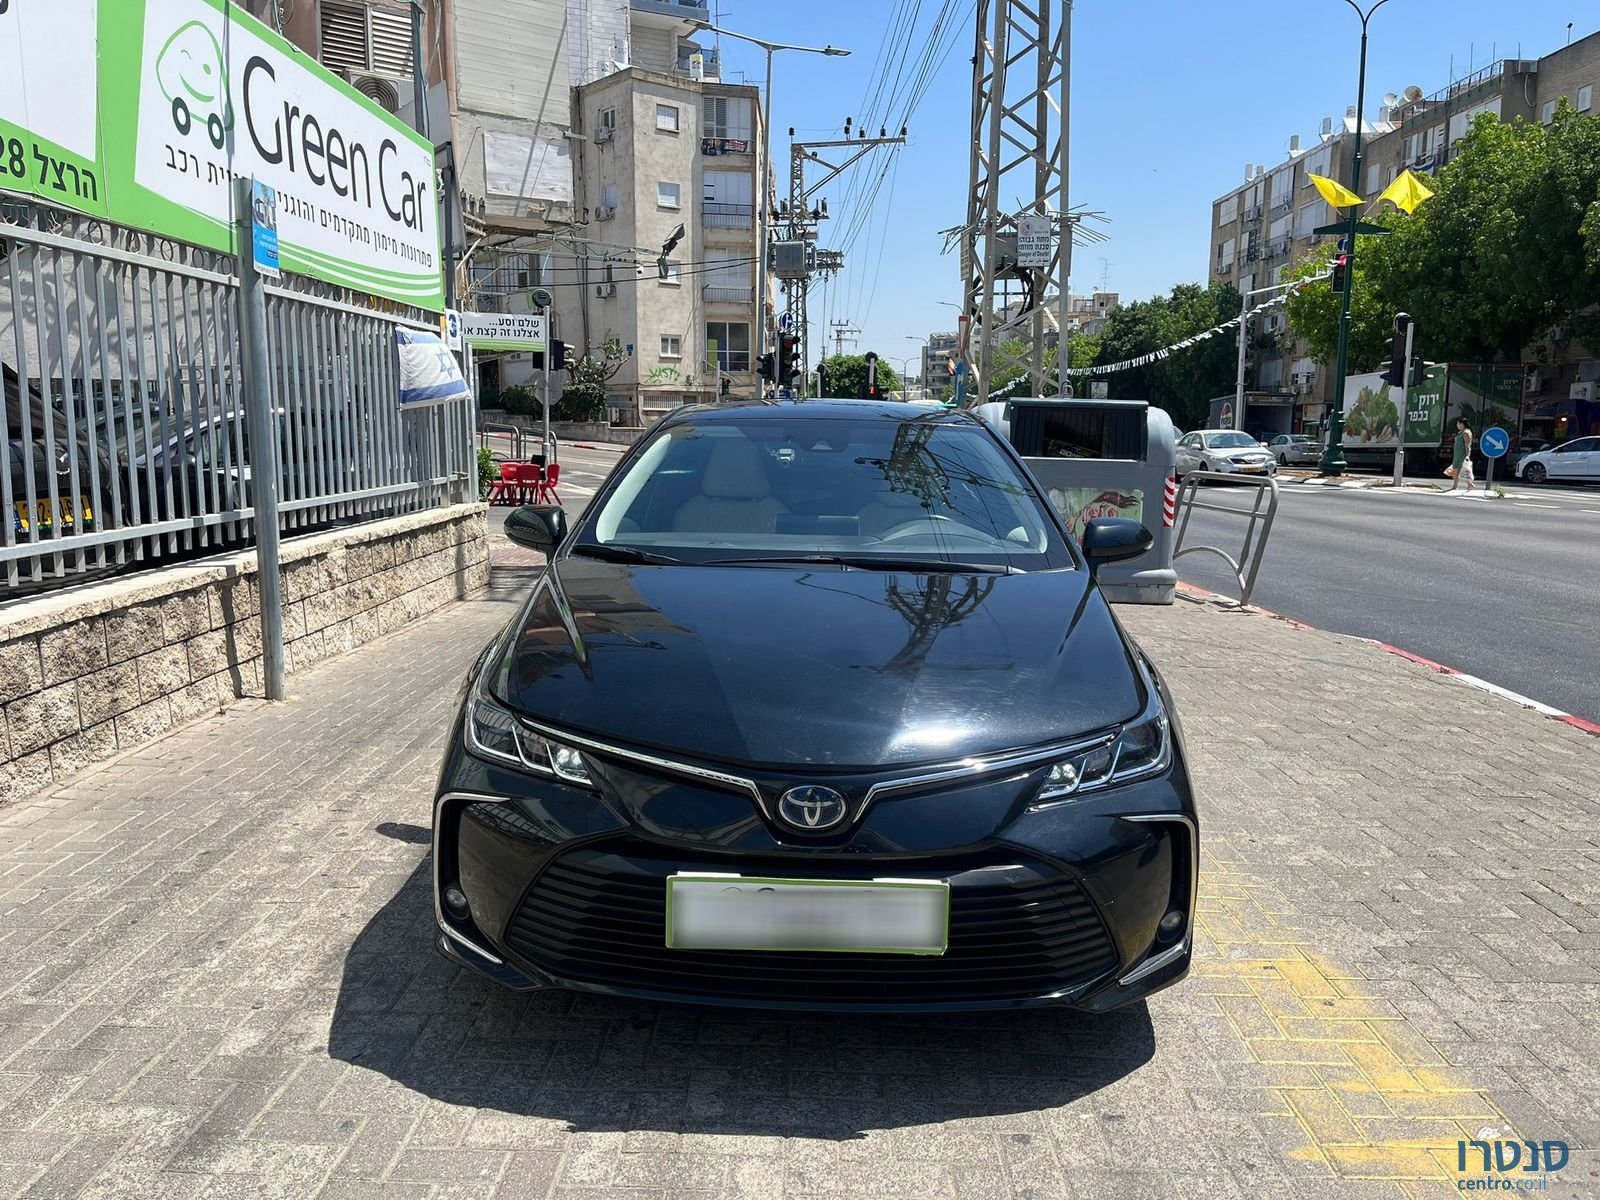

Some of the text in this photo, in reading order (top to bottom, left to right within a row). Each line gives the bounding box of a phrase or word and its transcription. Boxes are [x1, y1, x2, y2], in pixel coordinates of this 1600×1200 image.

[243, 56, 426, 232] Green Car
[32, 143, 98, 201] הרצל
[165, 144, 199, 178] רכב
[277, 190, 315, 223] והוגני
[320, 208, 370, 243] מתקדמים
[373, 230, 398, 253] מימון
[400, 242, 432, 268] פתרונות
[476, 327, 497, 338] קצת
[500, 328, 511, 337] זה
[513, 327, 540, 338] אצלנו
[518, 317, 539, 328] שלם
[1419, 393, 1440, 410] ירוק
[1408, 410, 1428, 421] בכפר
